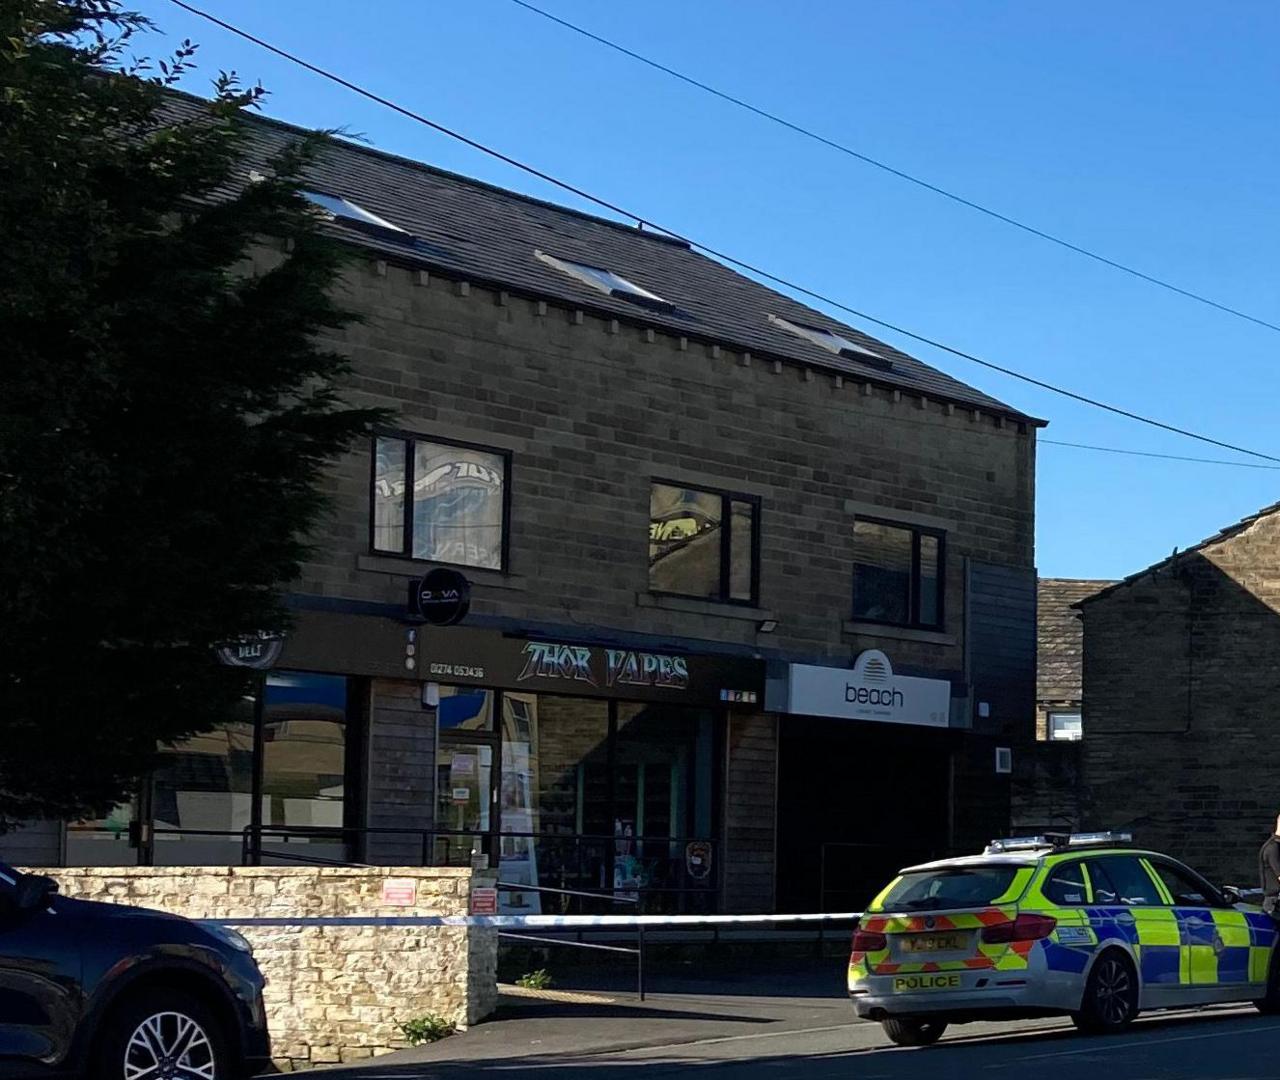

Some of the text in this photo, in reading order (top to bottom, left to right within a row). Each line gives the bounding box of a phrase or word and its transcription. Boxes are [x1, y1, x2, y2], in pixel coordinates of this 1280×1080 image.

[517, 641, 690, 690] THOR VAPES
[844, 681, 904, 707] beach
[895, 975, 960, 989] POLICE
